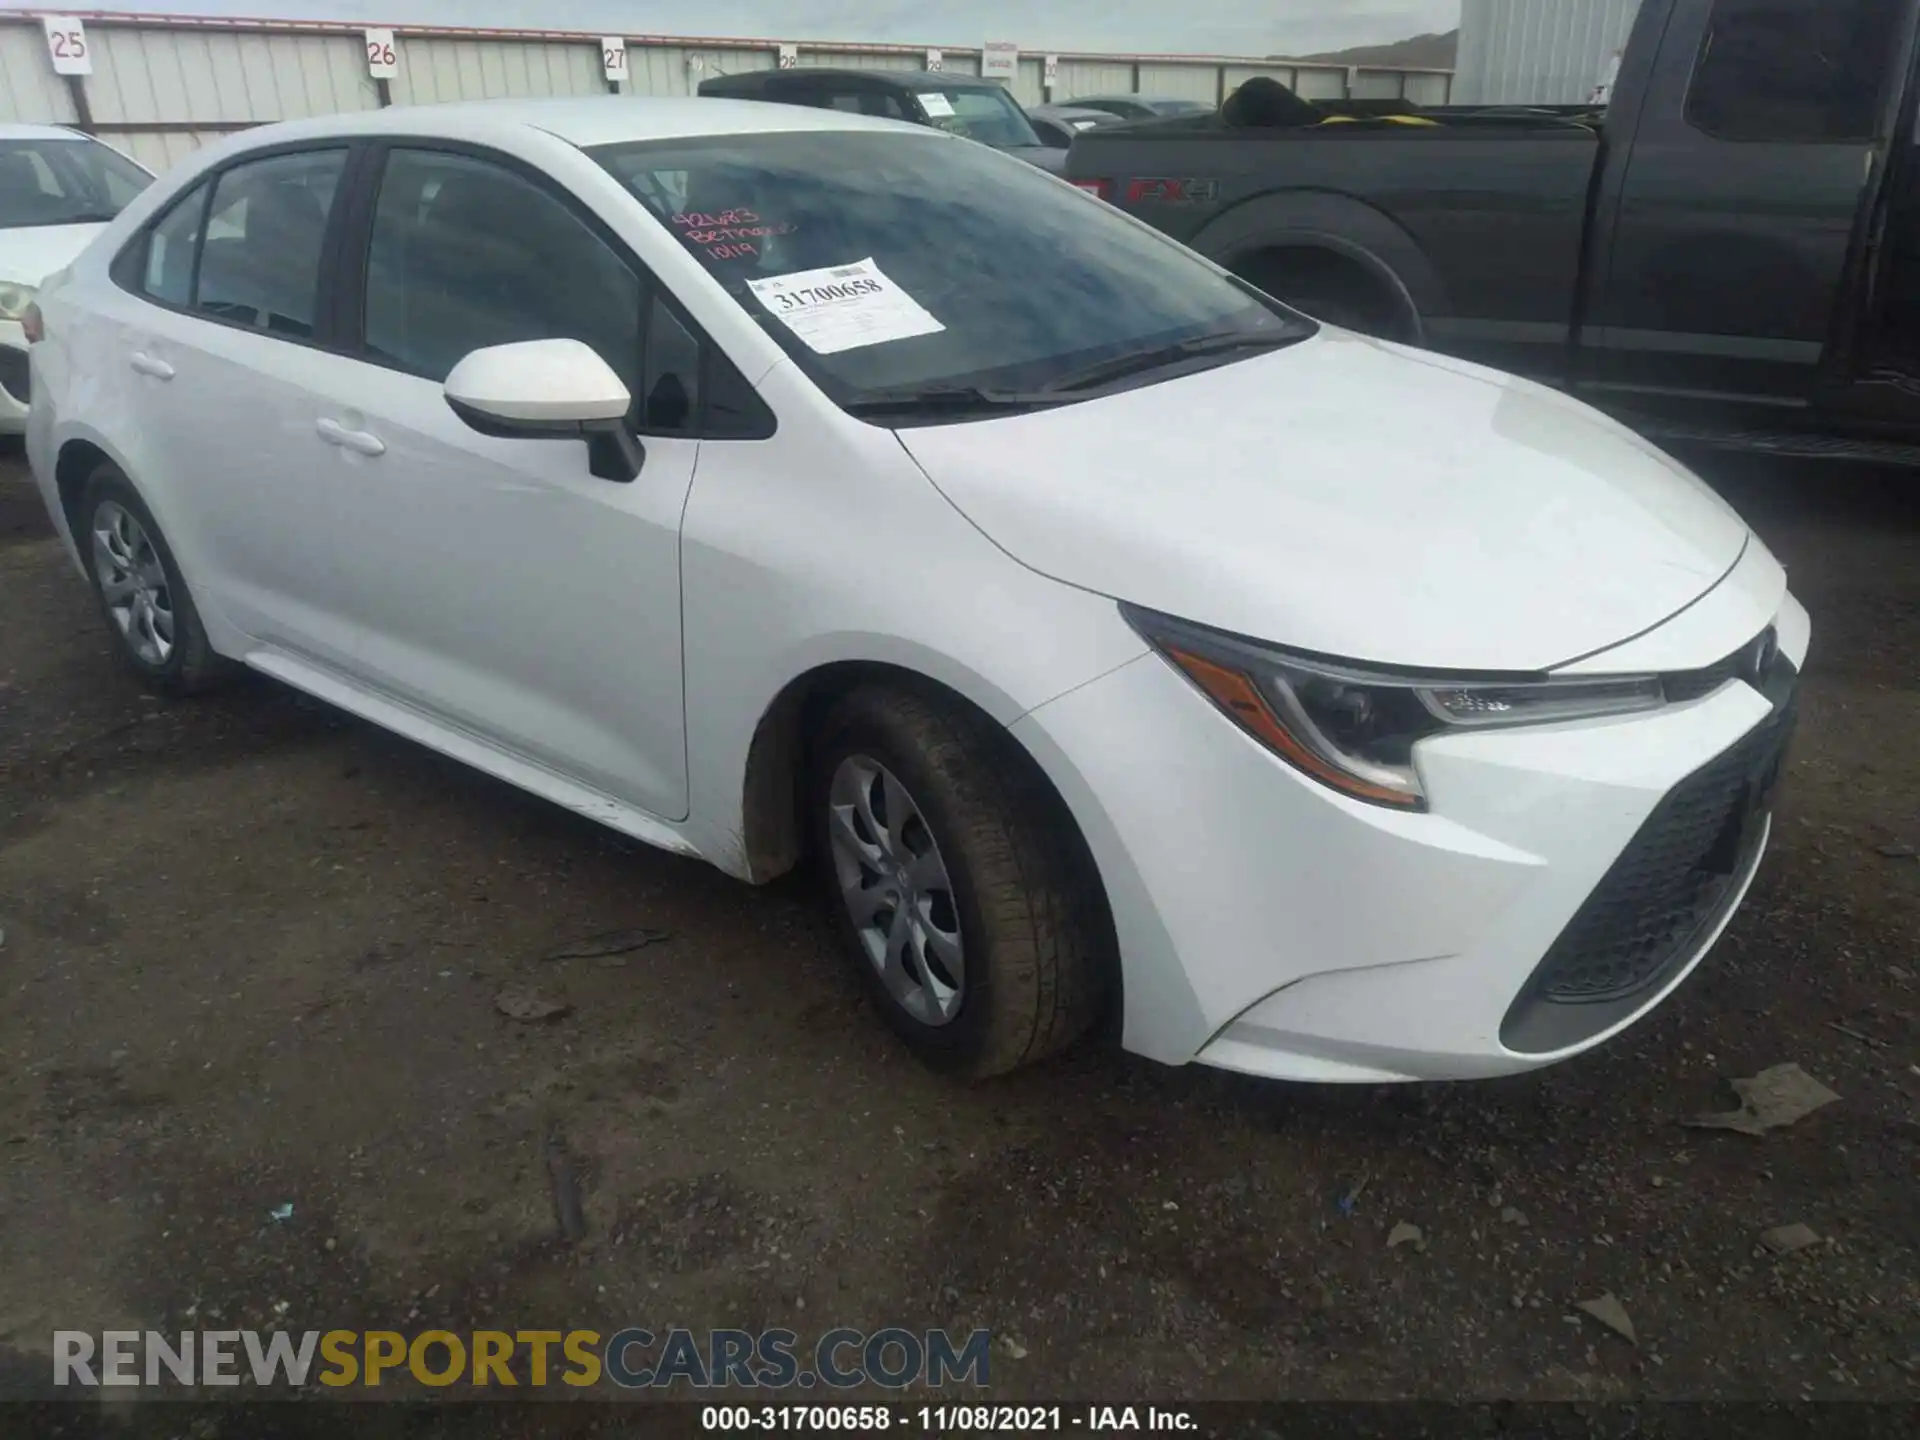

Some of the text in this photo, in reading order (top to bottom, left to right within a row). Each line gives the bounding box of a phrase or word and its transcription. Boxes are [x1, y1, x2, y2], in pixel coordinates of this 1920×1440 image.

[51, 31, 85, 58] 25
[368, 42, 396, 65] 26
[604, 48, 625, 69] 27
[1128, 176, 1219, 202] FX4
[774, 278, 884, 310] 31700658
